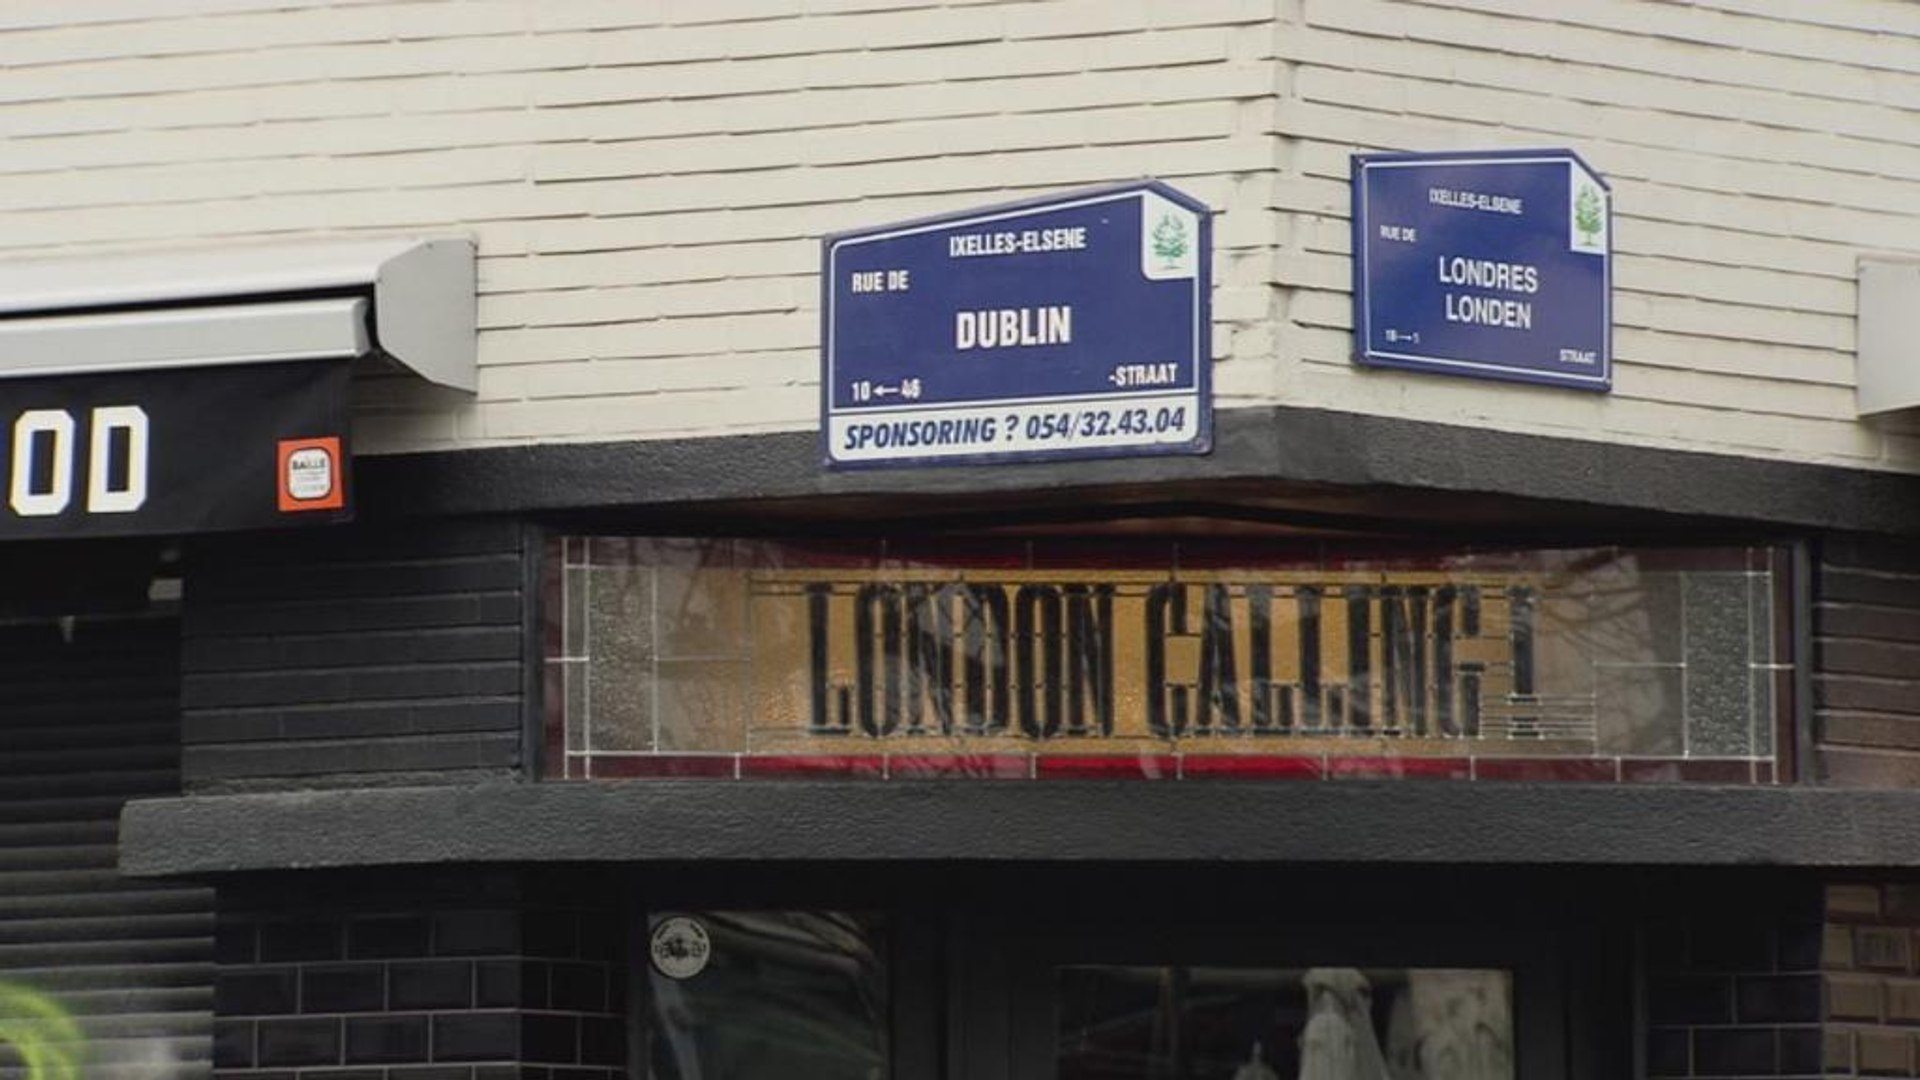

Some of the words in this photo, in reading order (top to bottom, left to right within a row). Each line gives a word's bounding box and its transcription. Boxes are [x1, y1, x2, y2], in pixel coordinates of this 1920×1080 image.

[1429, 188, 1522, 214] IXELLES-ELSENE
[950, 227, 1087, 257] IXELLES-ELSENE
[1380, 225, 1400, 241] RUE
[1401, 227, 1416, 242] DE
[851, 272, 884, 292] RUE
[888, 270, 909, 290] DE
[1439, 256, 1539, 293] LONDRES
[956, 306, 1072, 350] DUBLIN
[1446, 294, 1532, 329] LONDEN
[844, 417, 997, 450] SPONSORING
[1025, 407, 1185, 440] 054/32.43.04
[805, 581, 1114, 738] LONDON
